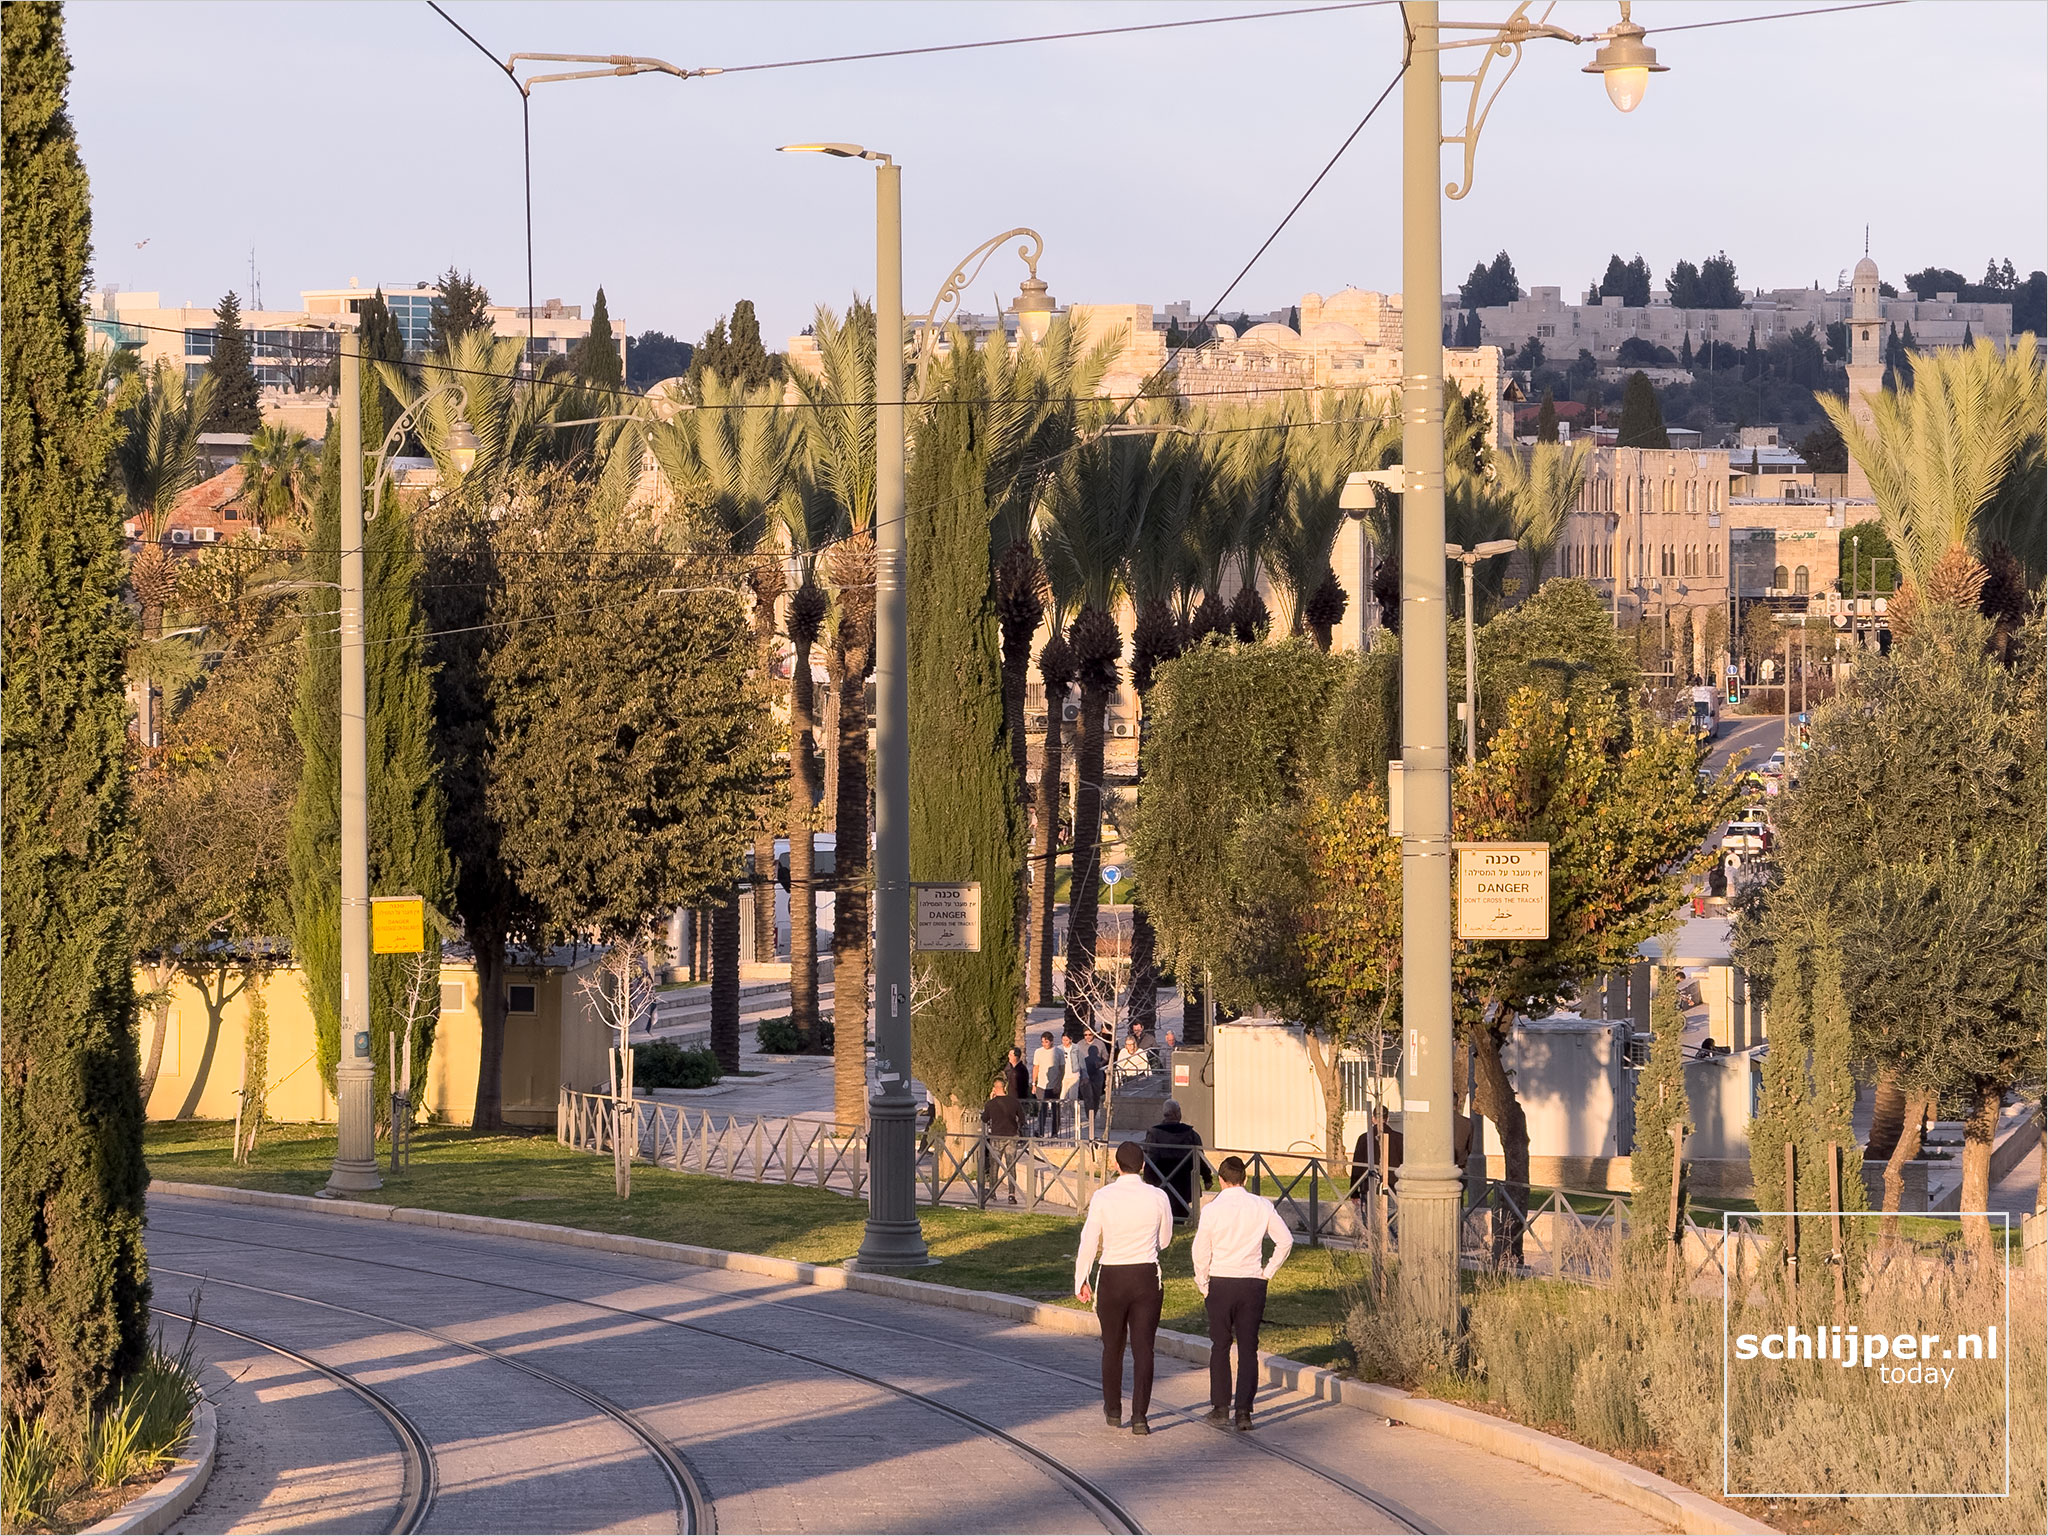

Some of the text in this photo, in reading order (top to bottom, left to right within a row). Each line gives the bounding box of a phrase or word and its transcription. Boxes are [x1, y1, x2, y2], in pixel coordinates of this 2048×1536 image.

[1485, 855, 1520, 864] סכנה
[1464, 868, 1496, 876] המסילה!
[1499, 868, 1508, 876] על
[1534, 870, 1543, 878] אין
[1478, 884, 1529, 892] DANGER
[1492, 908, 1512, 922] خطر
[939, 928, 954, 940] خطر
